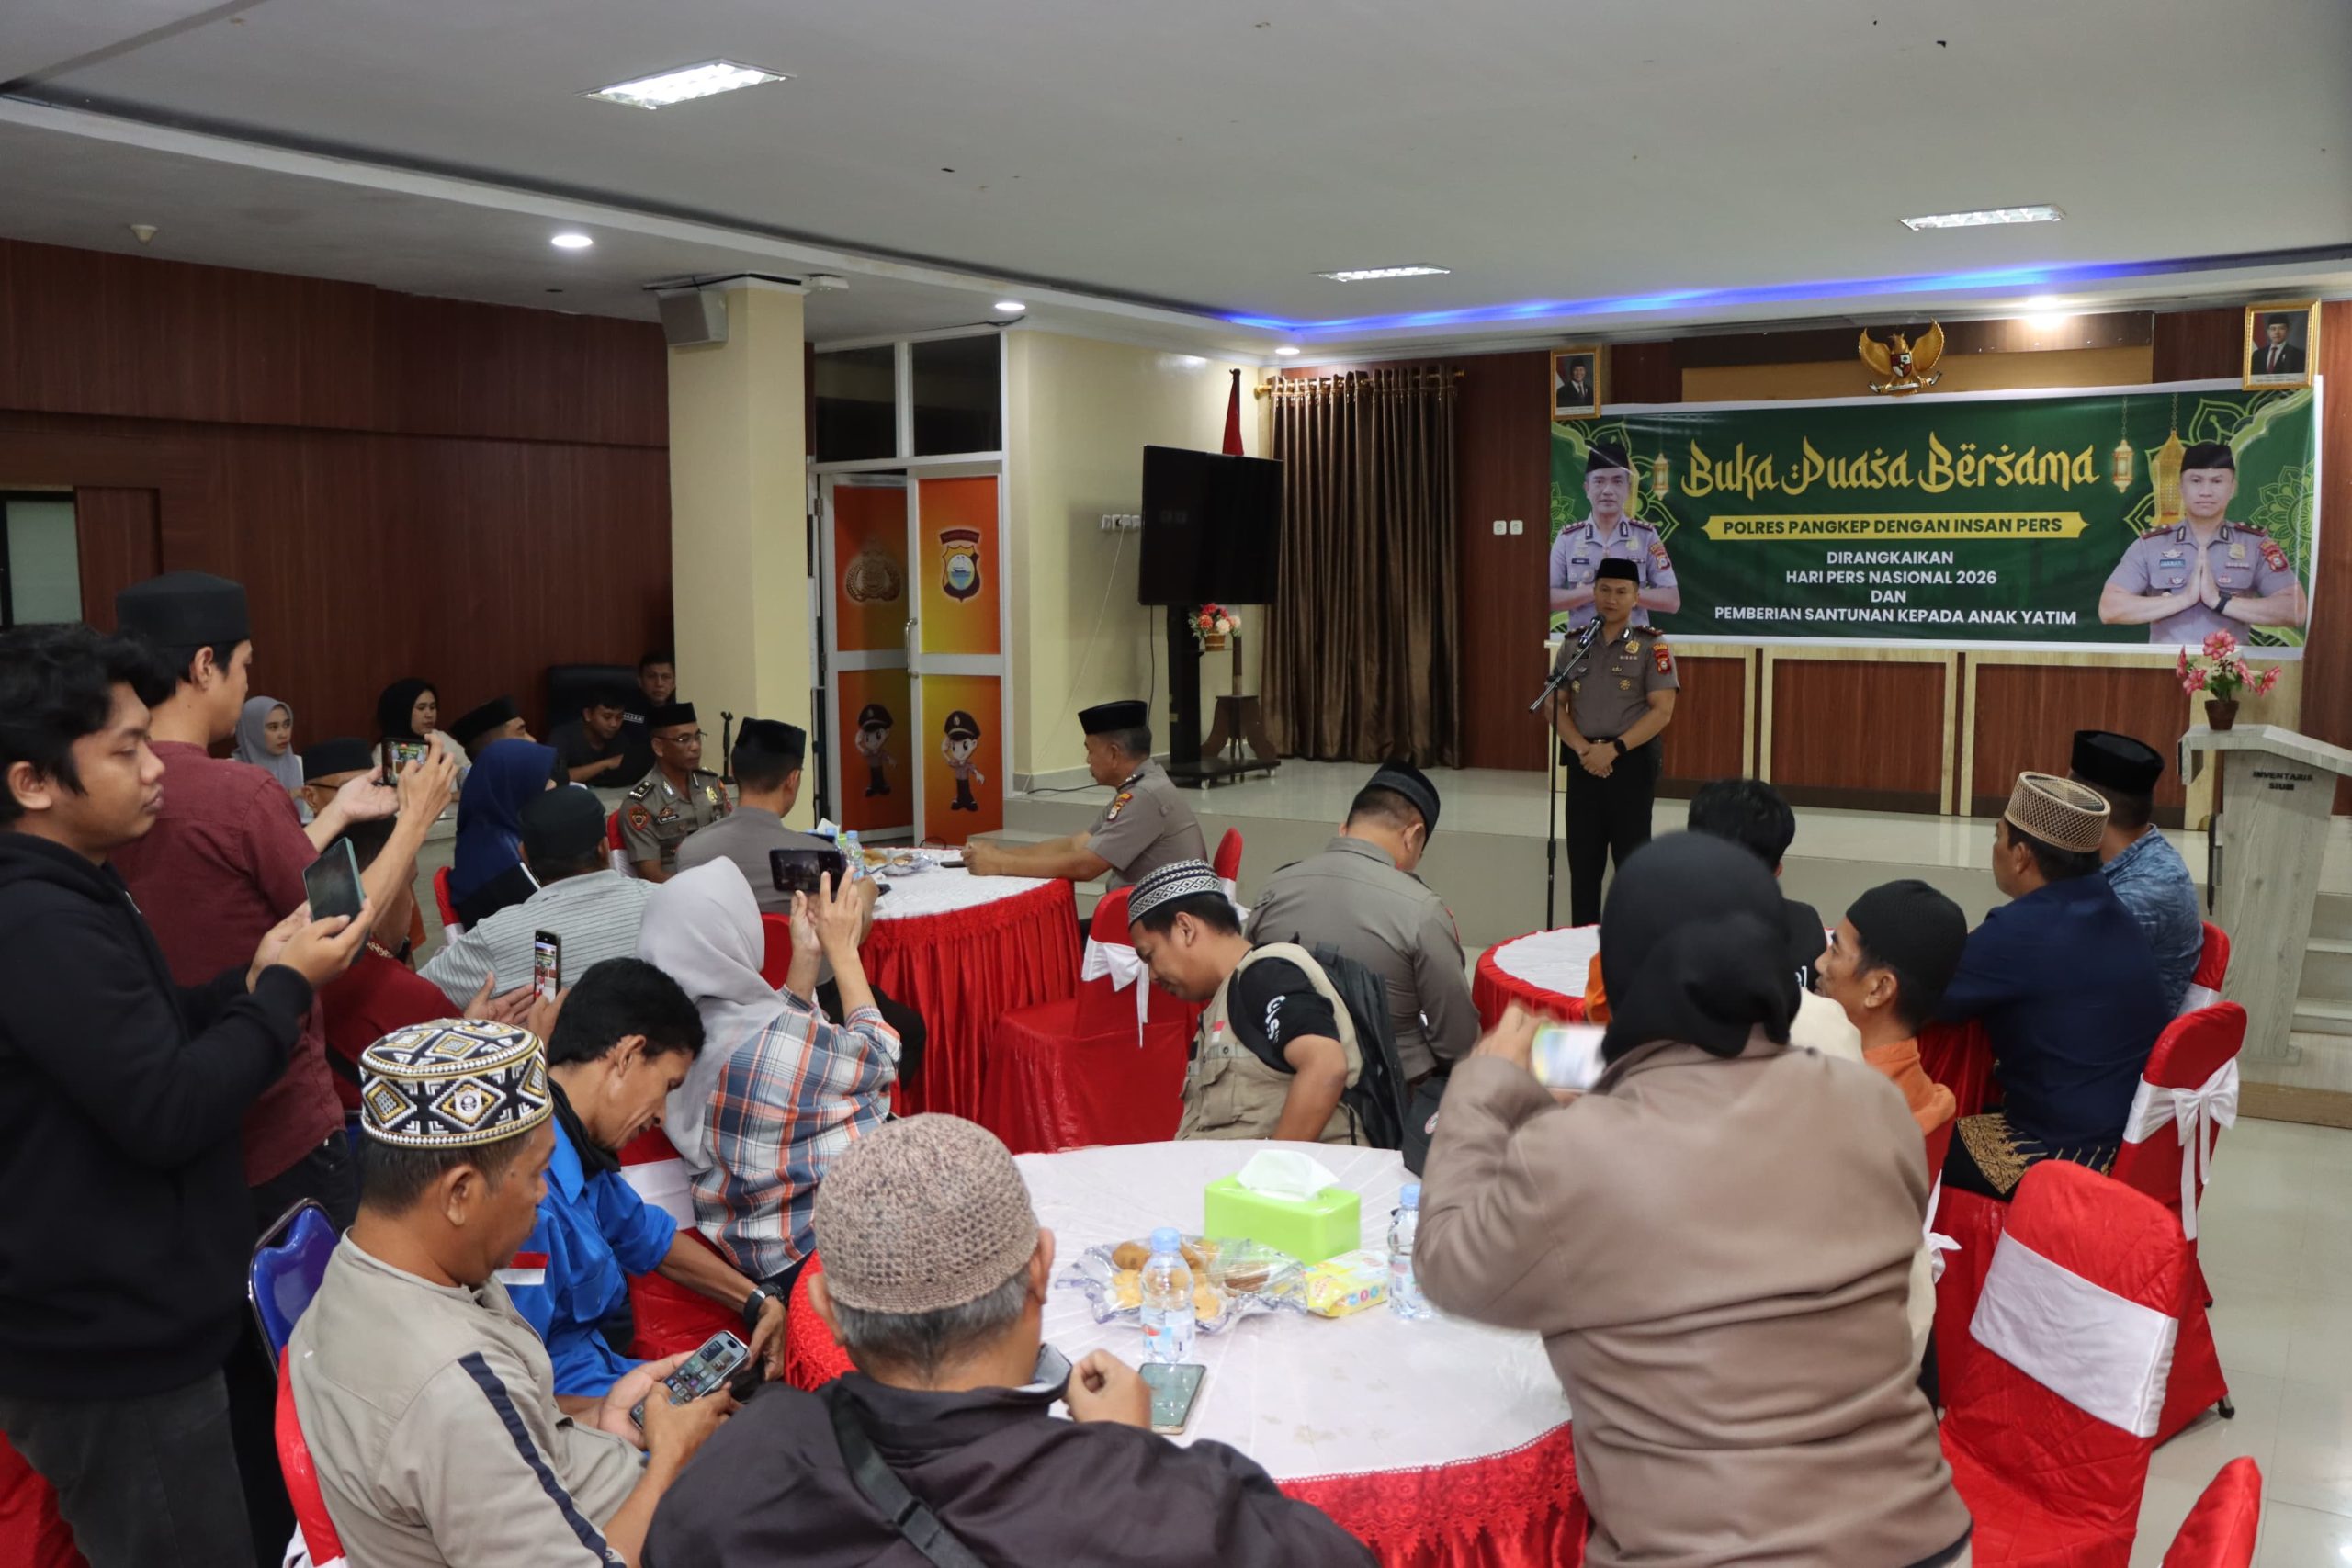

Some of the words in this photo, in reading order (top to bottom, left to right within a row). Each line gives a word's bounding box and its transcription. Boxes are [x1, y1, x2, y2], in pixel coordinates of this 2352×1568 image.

[1680, 438, 1779, 500] Buka
[1781, 435, 1914, 496] Puasa
[1724, 521, 1785, 535] POLRES
[1788, 520, 1871, 534] PANGKEP
[1873, 519, 1950, 533] DENGAN
[1954, 518, 2012, 533] INSAN
[2016, 518, 2063, 532] PERS
[1826, 551, 1954, 565] DIRANGKAIKAN
[1786, 570, 1824, 584] HARI
[1826, 570, 1865, 584] PERS
[1869, 570, 1953, 584] NASIONAL
[1956, 570, 1997, 584] 2026
[1871, 590, 1906, 604] DAN
[1714, 606, 1802, 620] PEMBERIAN
[1804, 607, 1894, 622] SANTUNAN
[1897, 609, 1964, 623] KEPADA
[1967, 610, 2018, 624] ANAK
[2021, 610, 2077, 625] YATIM
[2252, 771, 2313, 781] INVENTARIS
